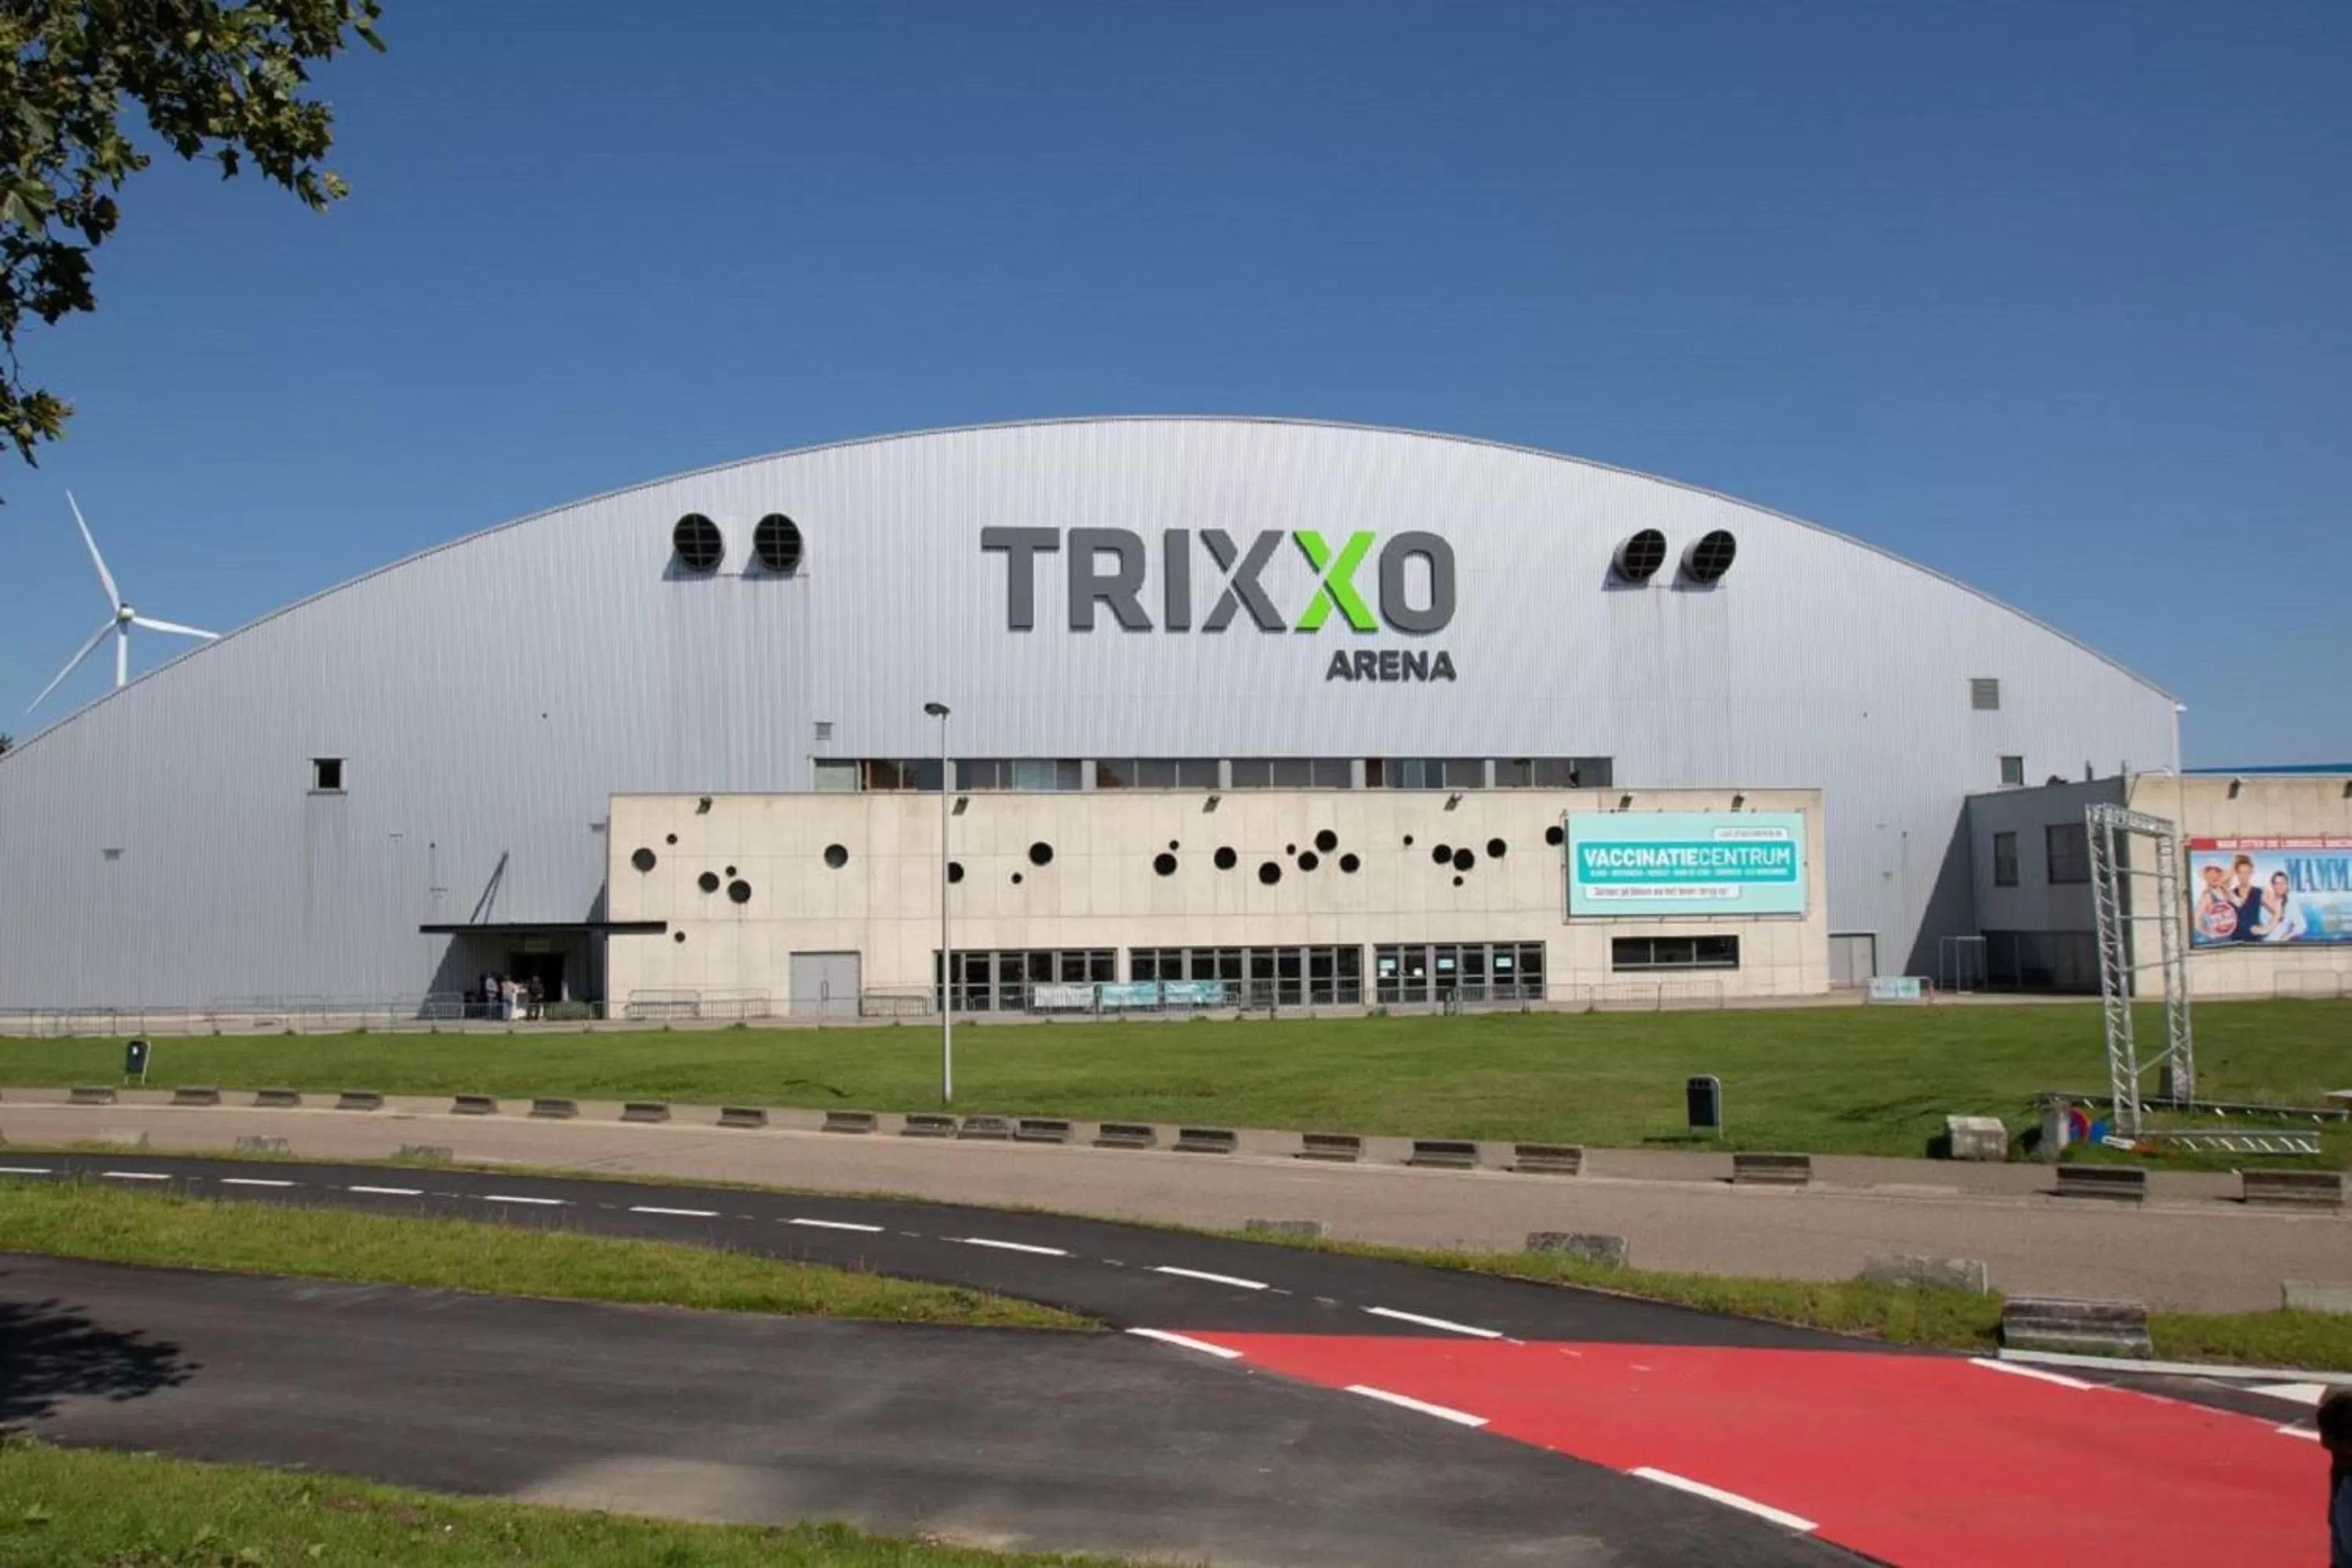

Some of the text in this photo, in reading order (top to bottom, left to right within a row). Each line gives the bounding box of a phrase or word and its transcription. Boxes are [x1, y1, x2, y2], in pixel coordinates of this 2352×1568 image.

[981, 526, 1456, 633] TRIXXO
[1326, 650, 1457, 681] ARENA
[1584, 848, 1790, 866] VACCINATIECENTRUM
[2285, 858, 2352, 892] MAMM
